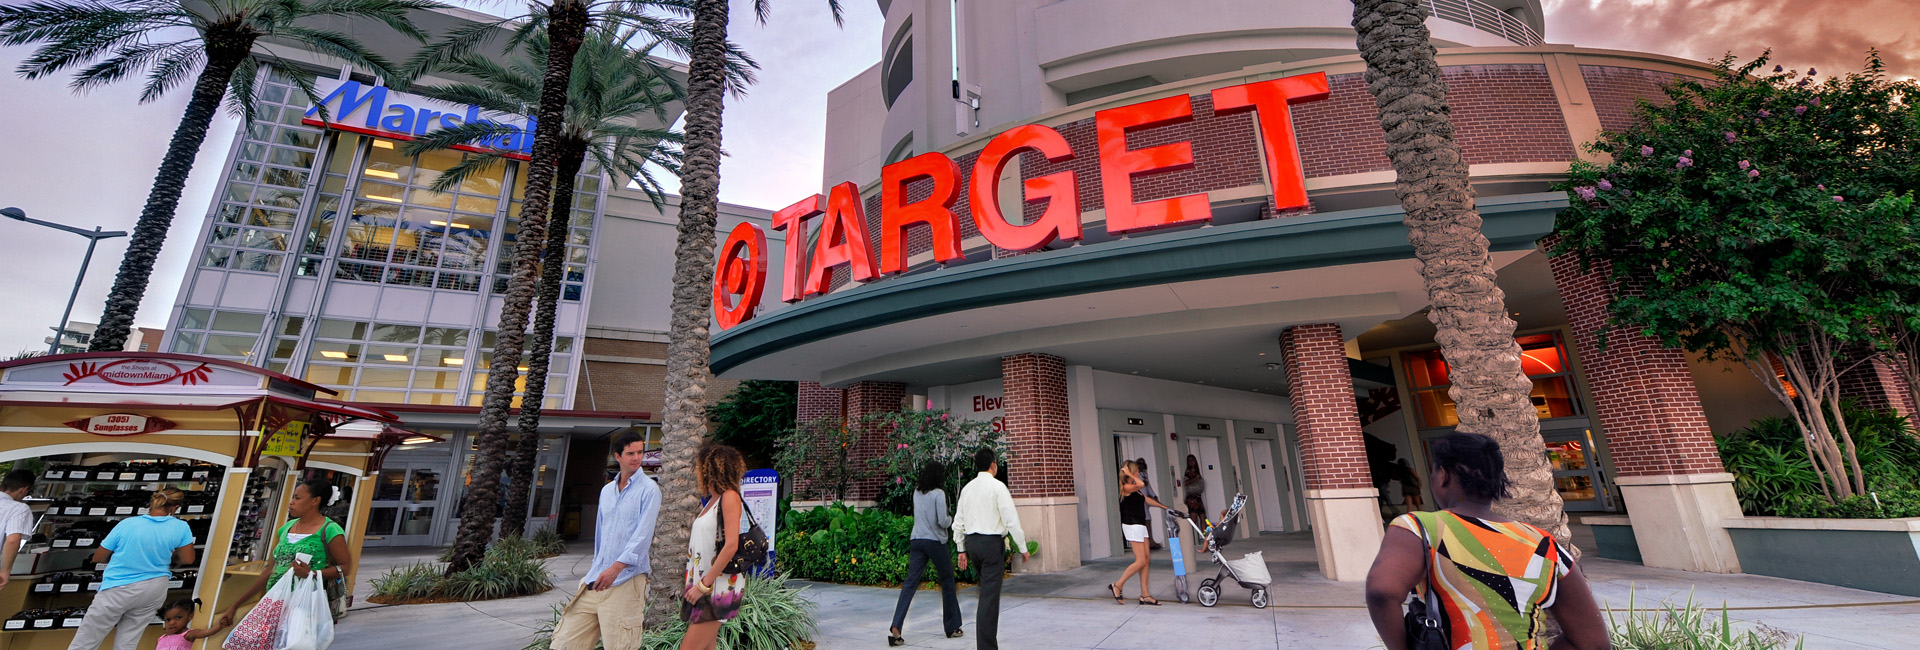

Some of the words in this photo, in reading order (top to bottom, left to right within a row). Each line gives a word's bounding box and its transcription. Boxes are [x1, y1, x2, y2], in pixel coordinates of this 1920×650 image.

[771, 71, 1330, 304] TARGET
[103, 370, 172, 380] midtownMiami
[973, 394, 1005, 413] Elev
[107, 415, 130, 423] (305)
[93, 423, 138, 432] Sunglasses
